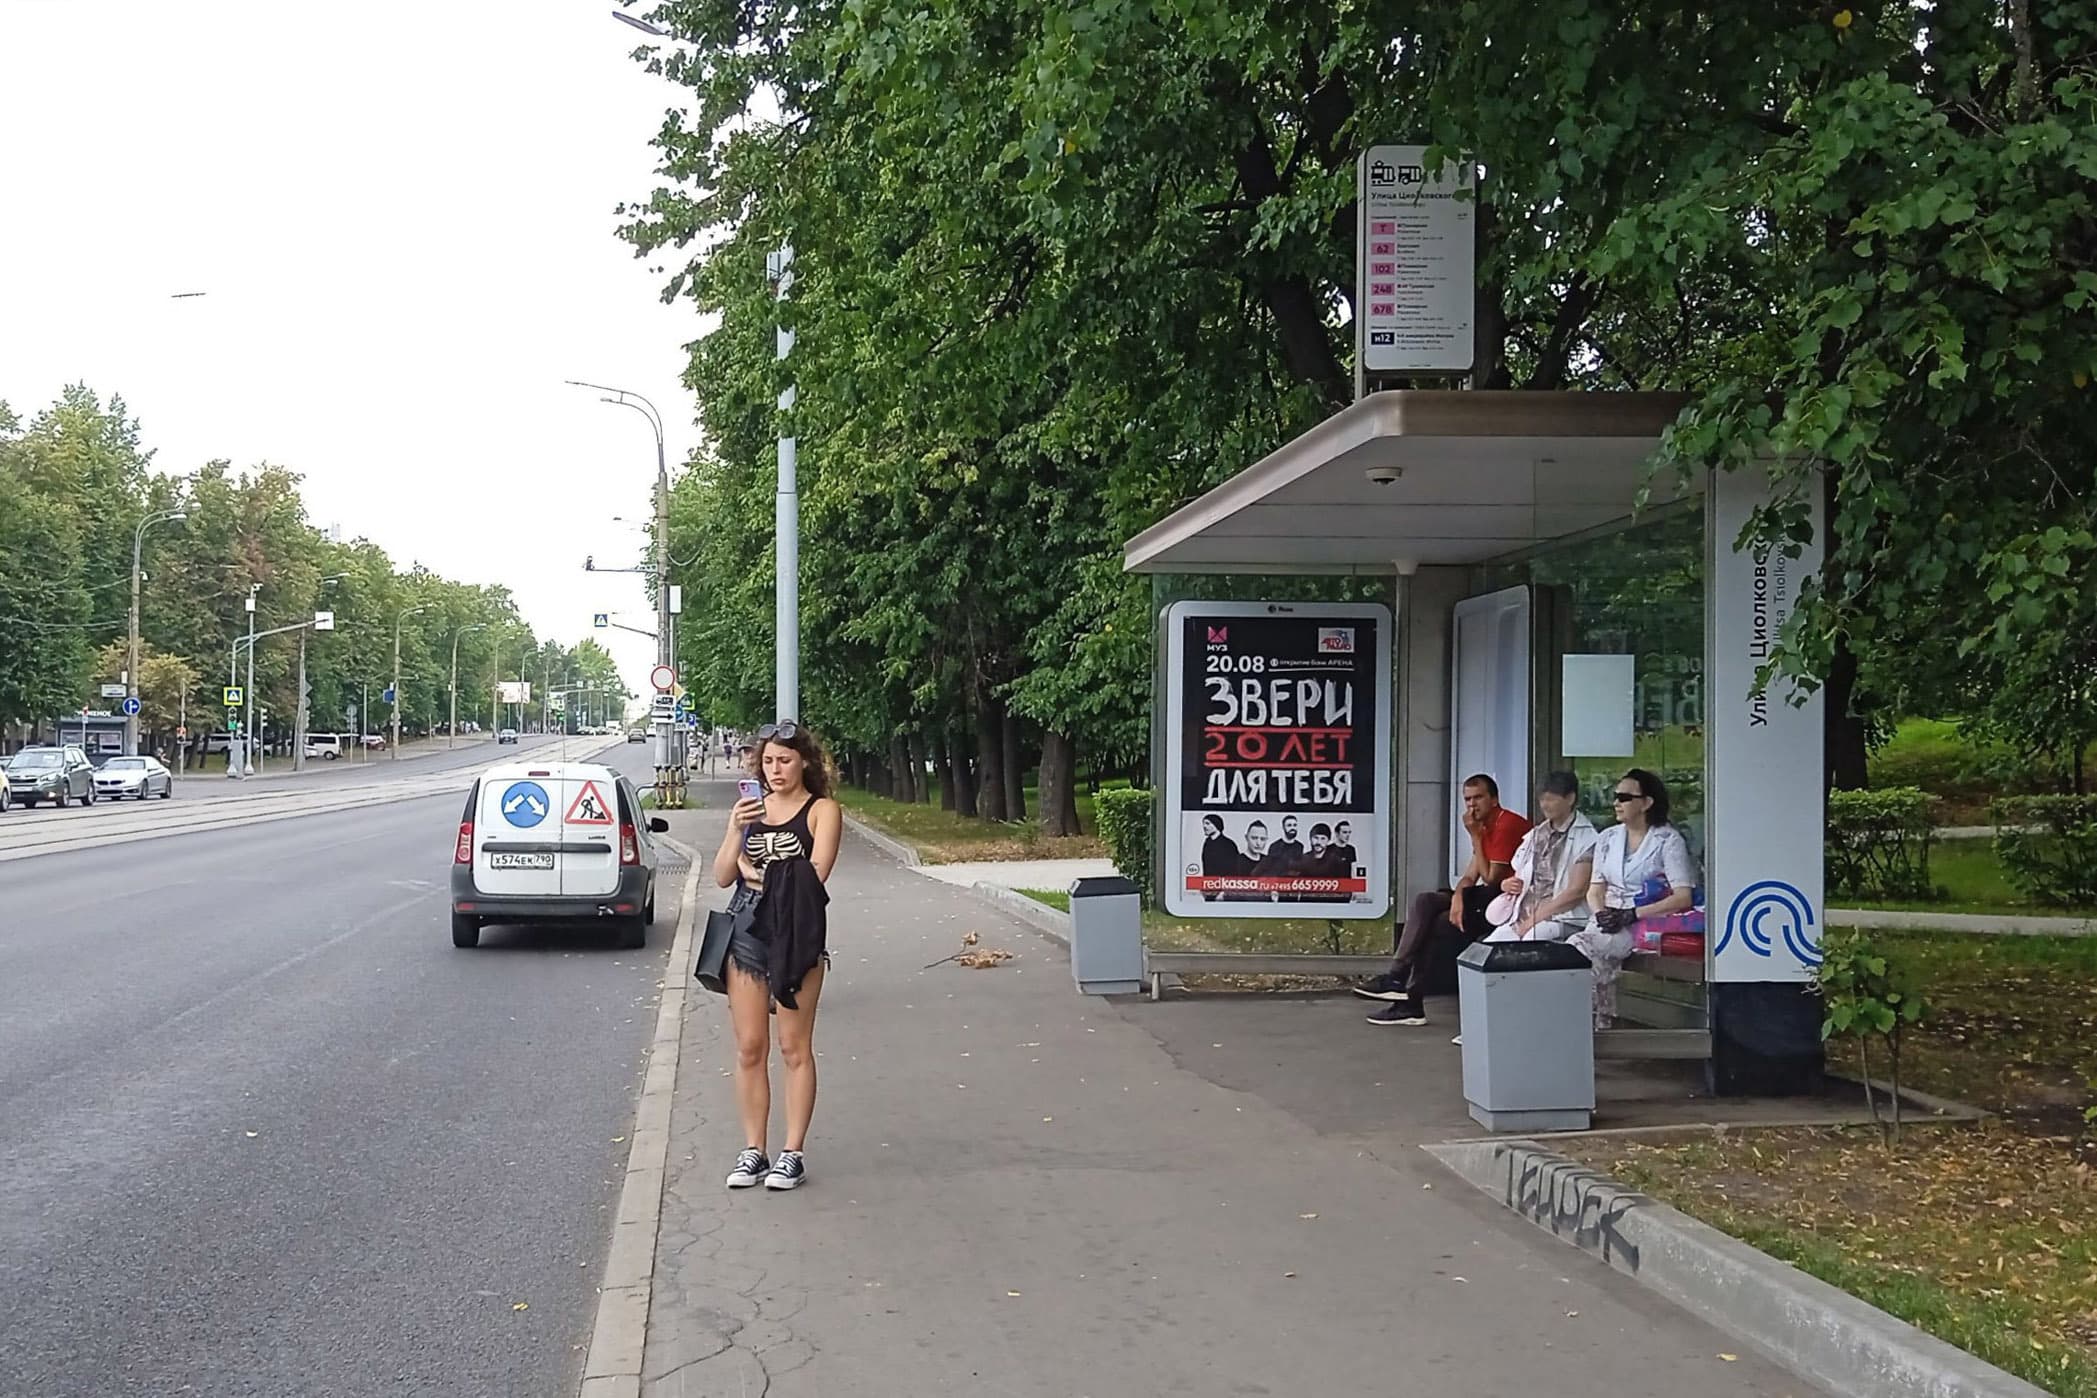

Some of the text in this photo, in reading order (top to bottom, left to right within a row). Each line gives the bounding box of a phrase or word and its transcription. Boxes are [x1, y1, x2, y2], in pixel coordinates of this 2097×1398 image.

[1371, 192, 1457, 200] Улица Циоковског
[1376, 244, 1389, 254] 62
[1375, 265, 1390, 273] 102
[1206, 644, 1228, 652] МУЗ
[1206, 656, 1265, 673] 20.08
[1204, 677, 1353, 726] ЗВЕРИ
[1750, 665, 1767, 727] Улиа
[1205, 732, 1351, 762] 20 ЛЕТ
[1201, 769, 1353, 805] ДЛЯ ТЕБЯ
[1203, 877, 1269, 891] redkassa.ru
